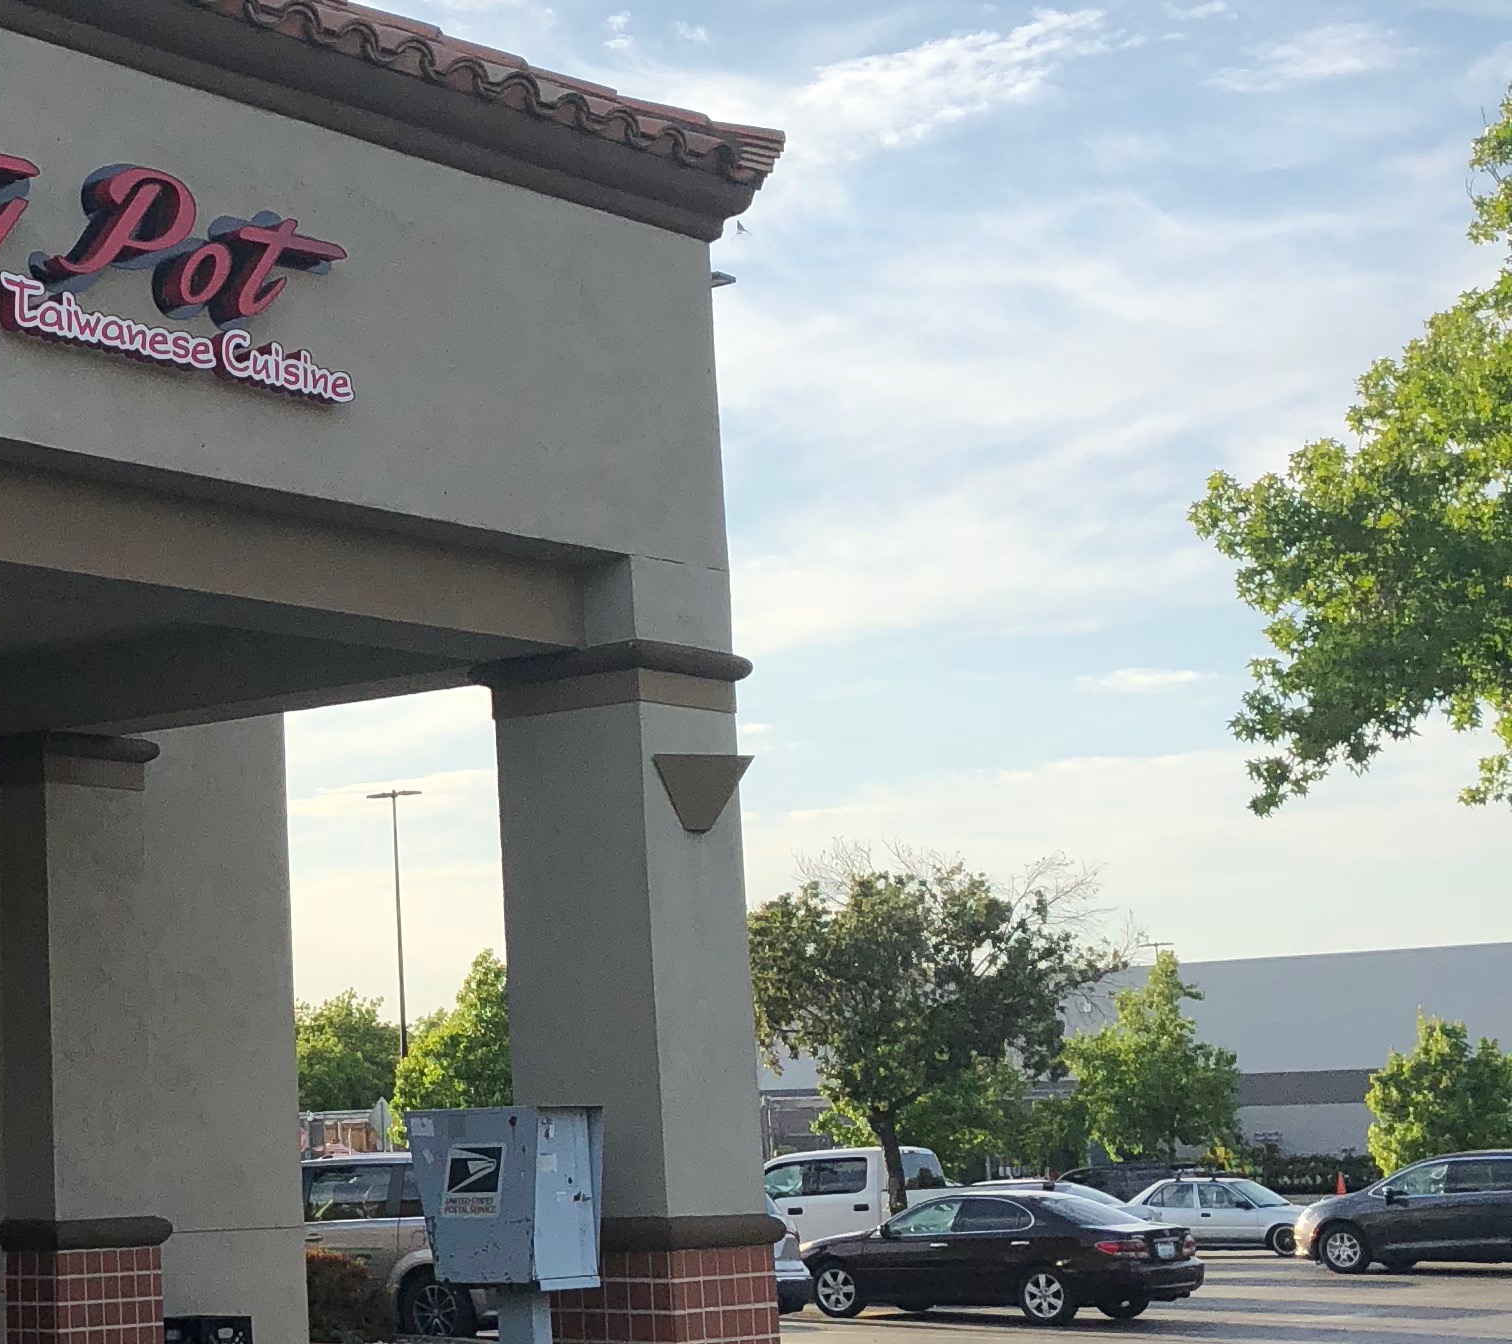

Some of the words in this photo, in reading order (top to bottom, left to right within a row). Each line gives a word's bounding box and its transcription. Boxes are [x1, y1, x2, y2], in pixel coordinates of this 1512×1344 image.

[40, 166, 347, 318] Pot
[0, 271, 217, 369] Taiwanese
[222, 329, 356, 402] Cuisine
